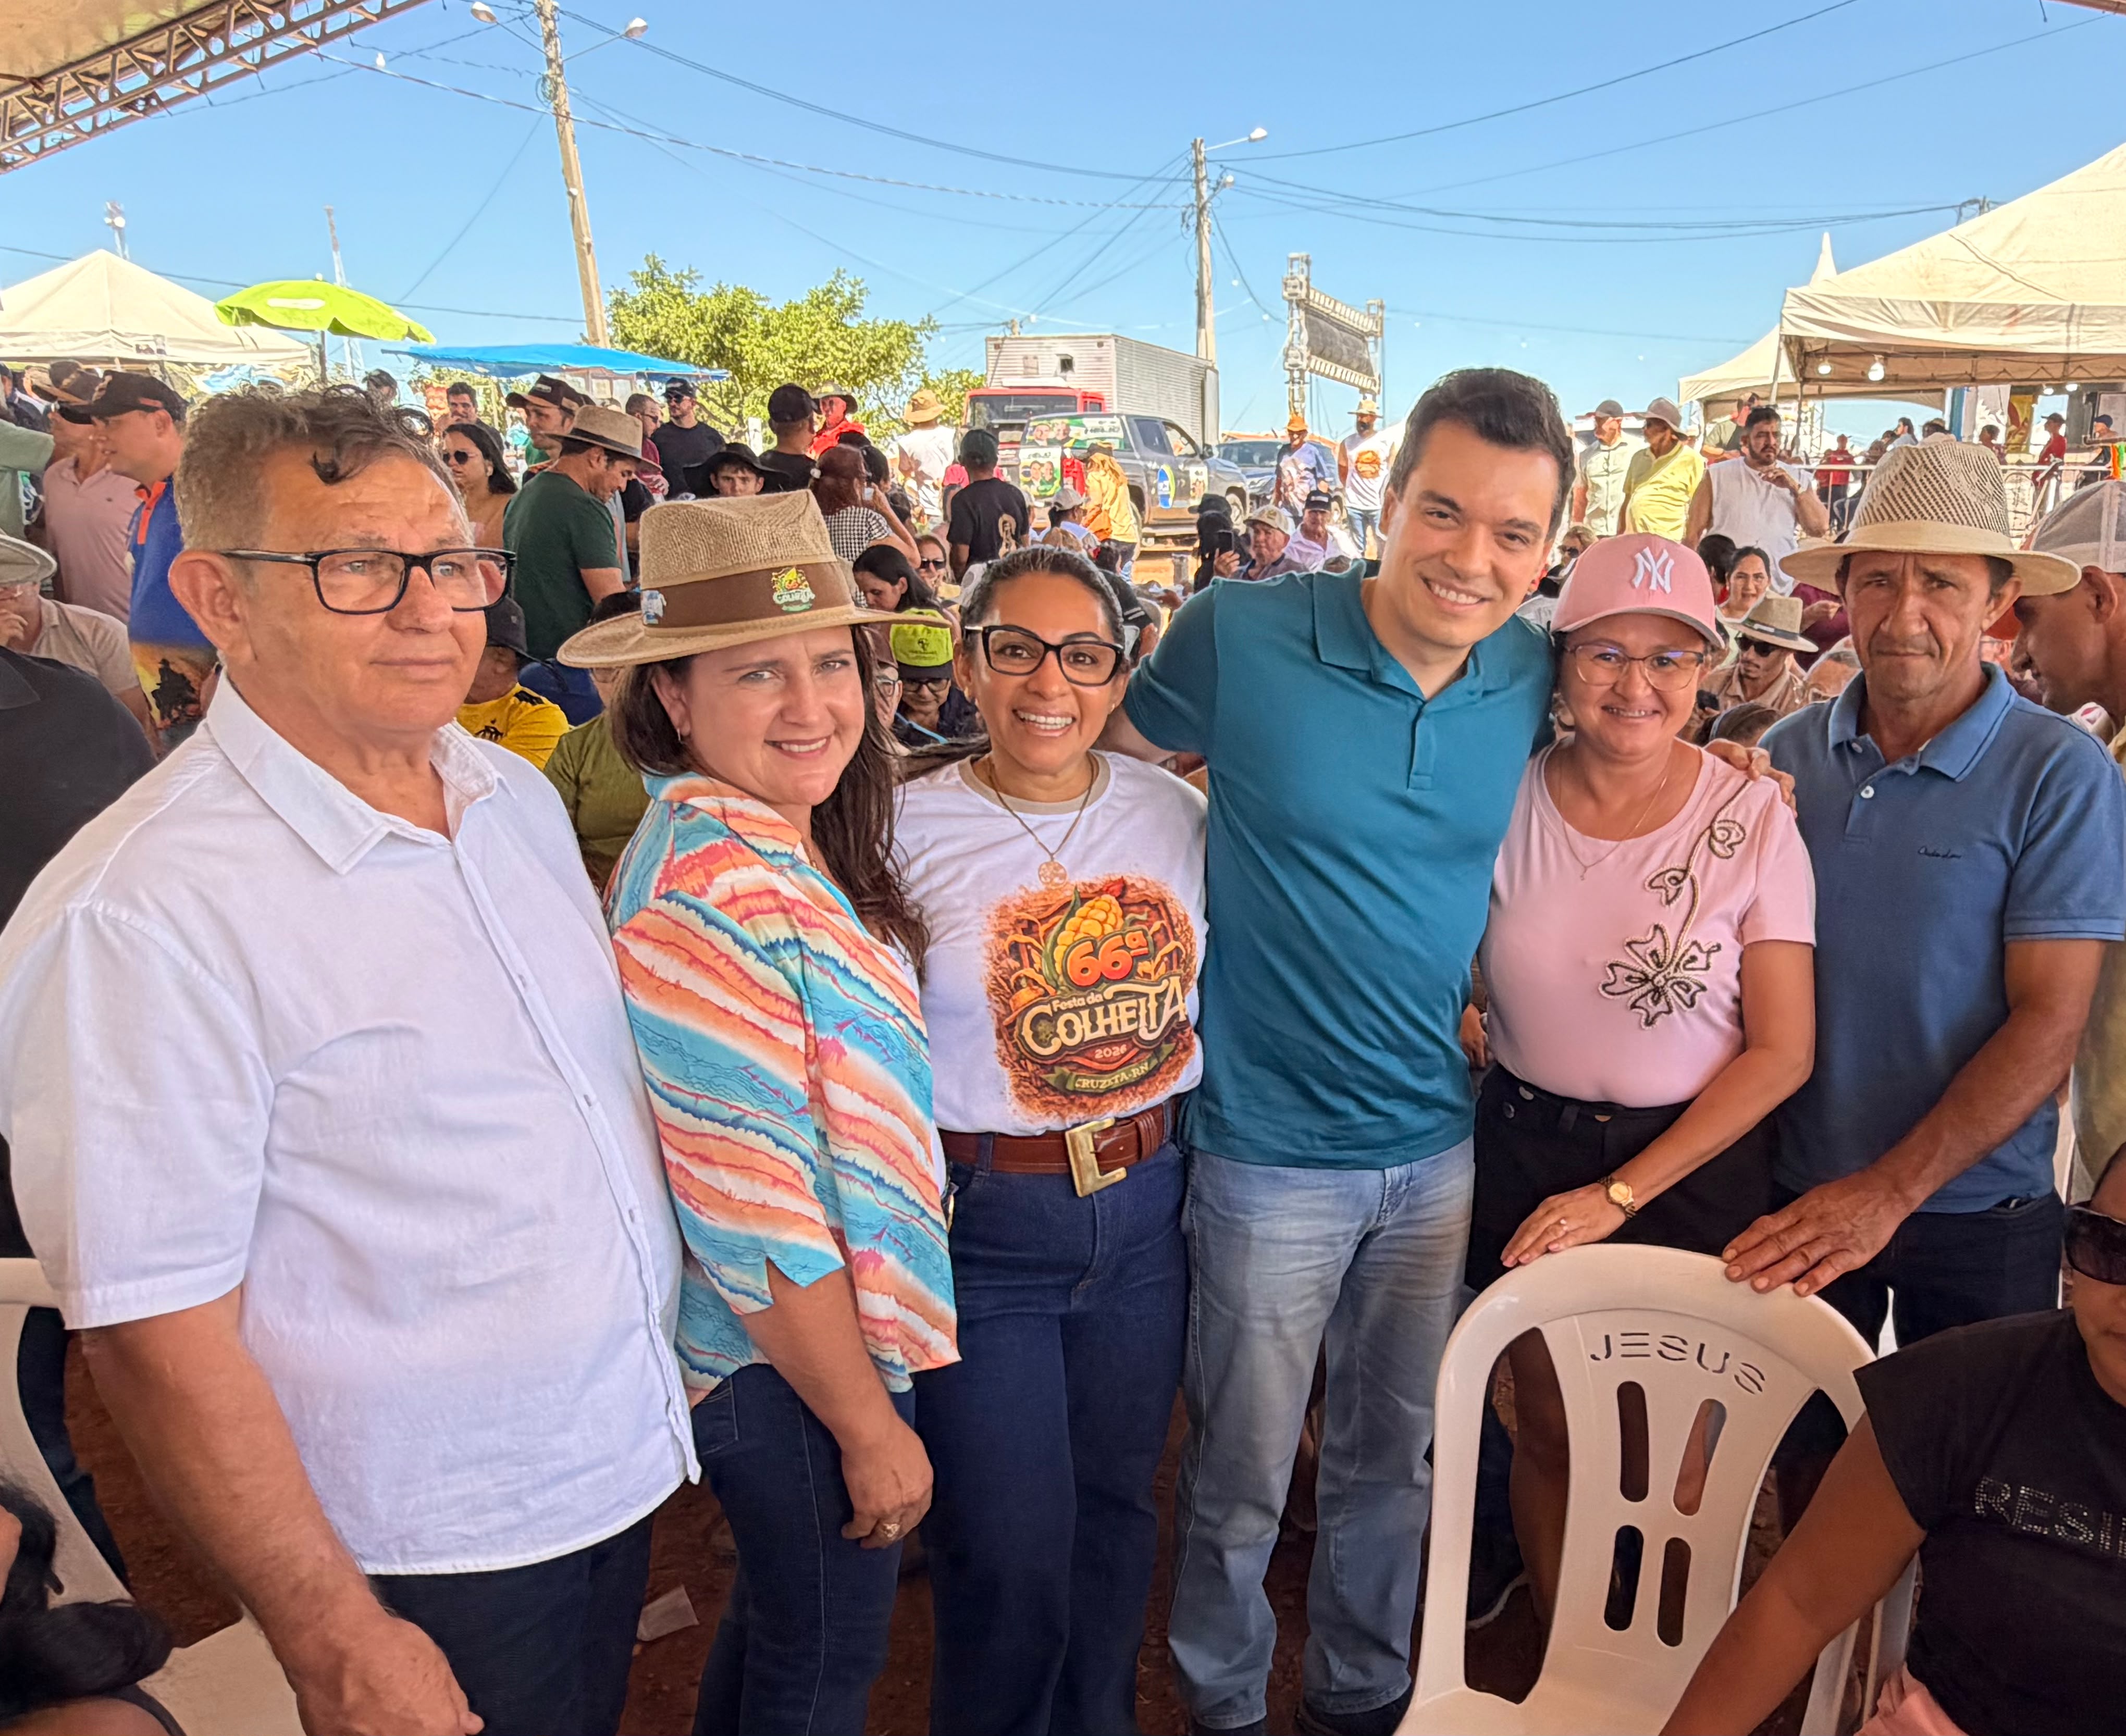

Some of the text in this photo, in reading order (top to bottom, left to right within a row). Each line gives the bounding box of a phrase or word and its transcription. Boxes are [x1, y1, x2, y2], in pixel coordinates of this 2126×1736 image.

[1632, 547, 1675, 594] NY
[1022, 976, 1187, 1056] COLHEITA
[1052, 992, 1103, 1011] Festa da
[1590, 1333, 1765, 1395] JESUS
